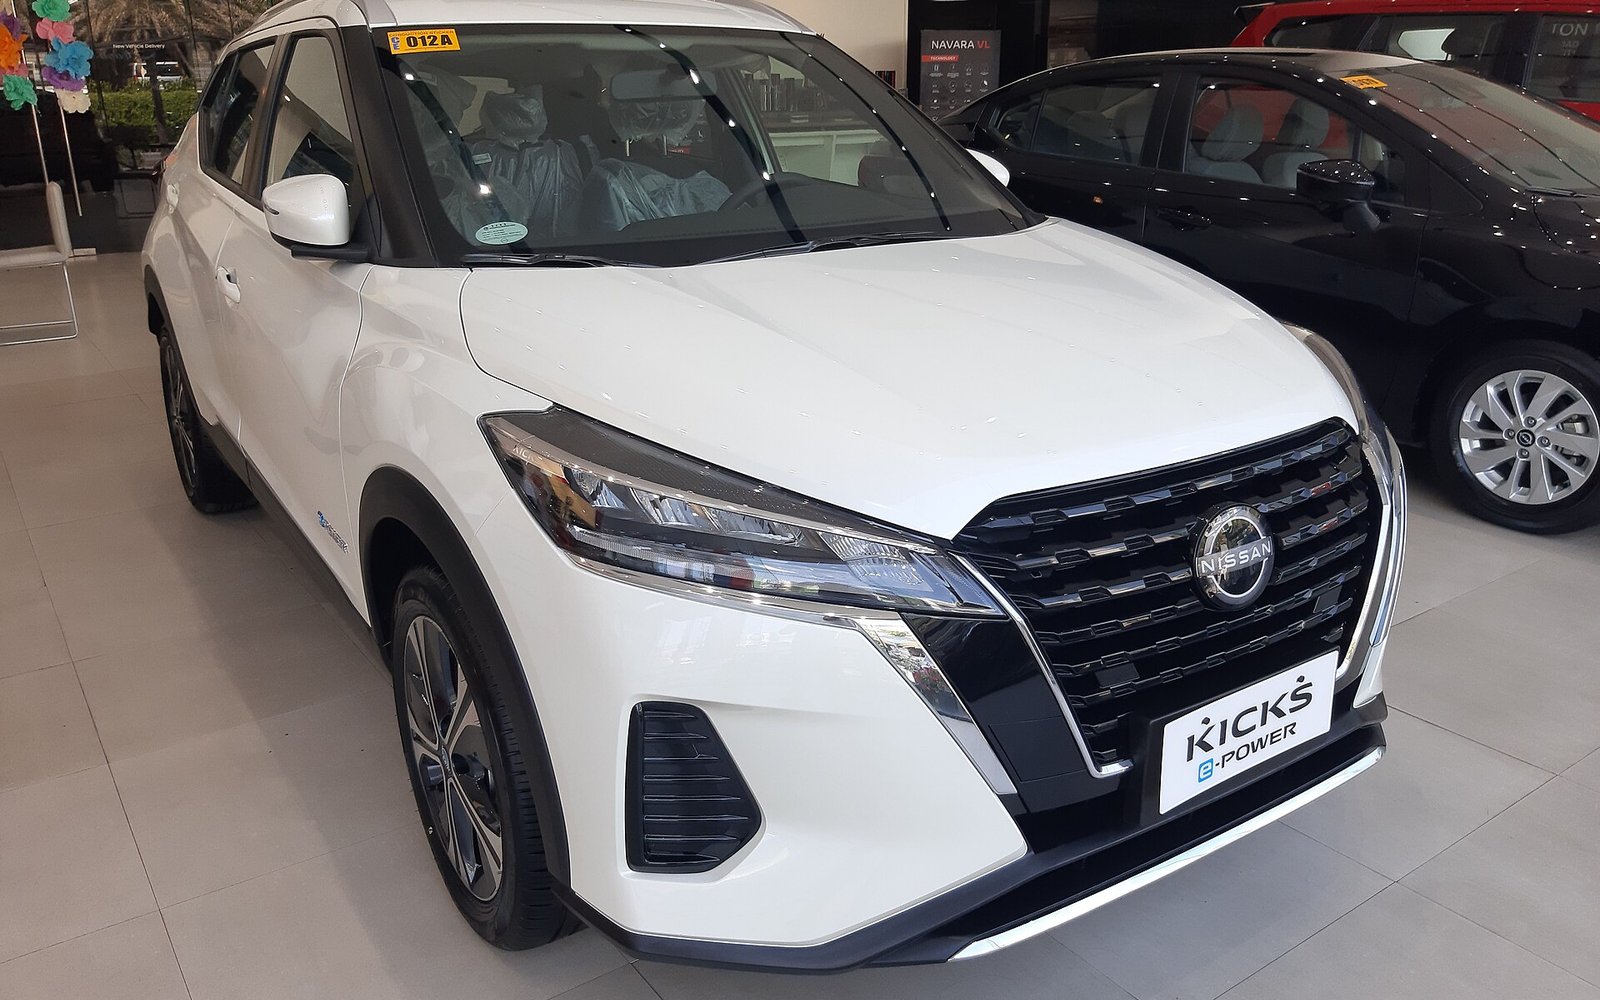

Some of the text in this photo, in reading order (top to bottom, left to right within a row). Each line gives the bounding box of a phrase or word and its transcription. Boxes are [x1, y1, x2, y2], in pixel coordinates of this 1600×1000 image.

[405, 34, 453, 48] 012A
[931, 40, 991, 50] NAVARA VL
[1200, 540, 1272, 574] NISSAN
[1186, 675, 1313, 762] KICKS
